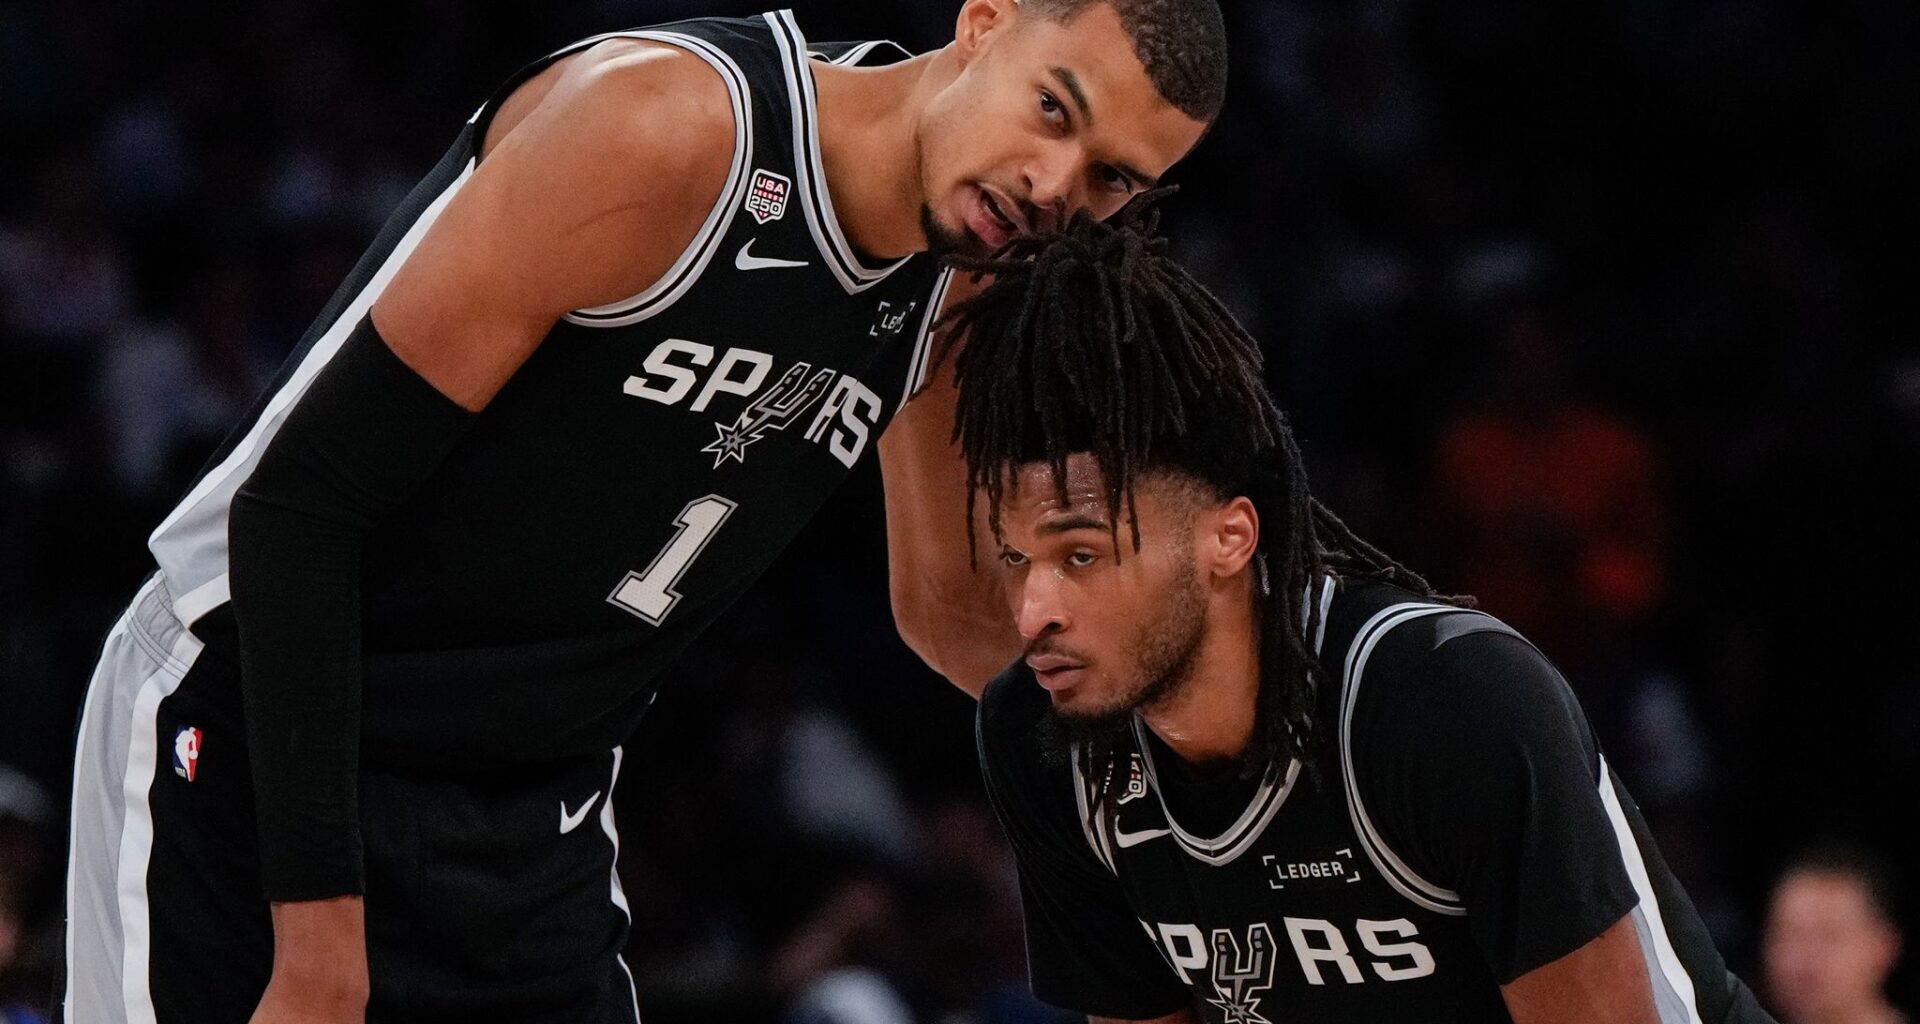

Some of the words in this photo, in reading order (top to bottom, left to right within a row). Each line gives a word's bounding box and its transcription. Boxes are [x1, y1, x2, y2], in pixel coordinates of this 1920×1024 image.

[750, 195, 782, 216] 250
[756, 176, 784, 195] USA
[623, 338, 883, 470] SPURS
[606, 493, 739, 628] 1
[1276, 861, 1345, 880] LEDGER
[1137, 916, 1436, 1024] PURS
